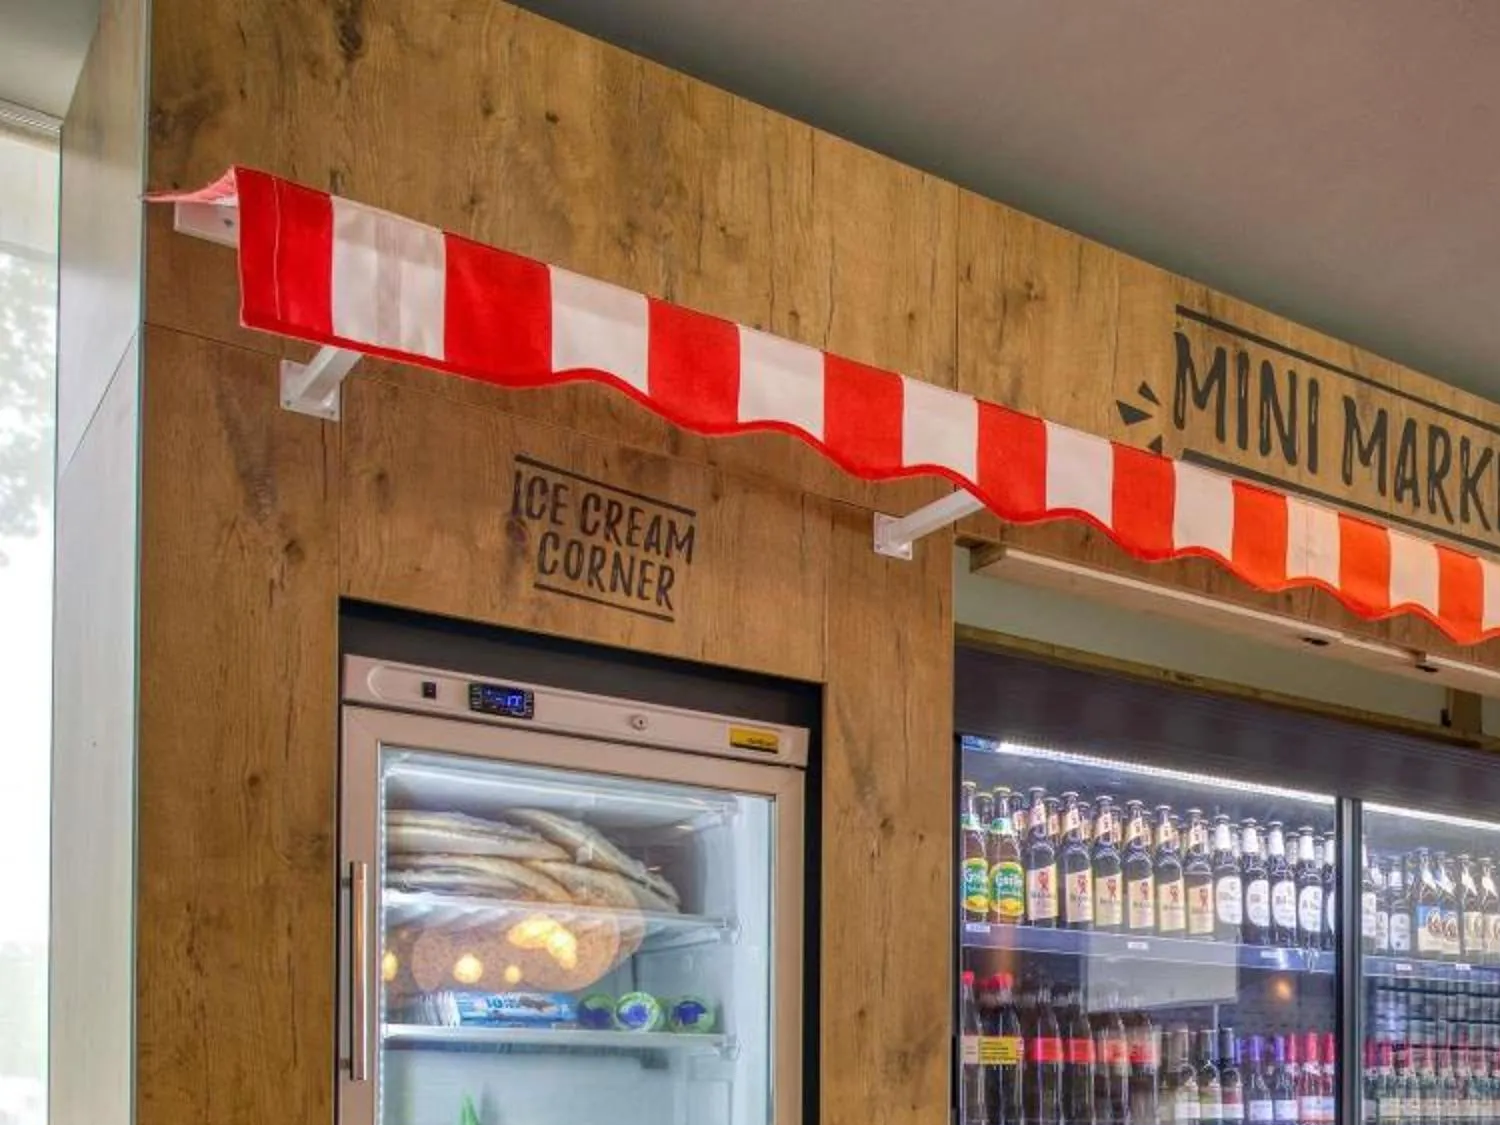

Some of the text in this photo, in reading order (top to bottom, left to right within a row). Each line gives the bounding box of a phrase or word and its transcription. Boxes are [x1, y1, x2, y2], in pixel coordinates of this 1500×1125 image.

[1173, 330, 1320, 475] MINI
[511, 469, 697, 566] ICE CREAM
[537, 531, 676, 612] CORNER
